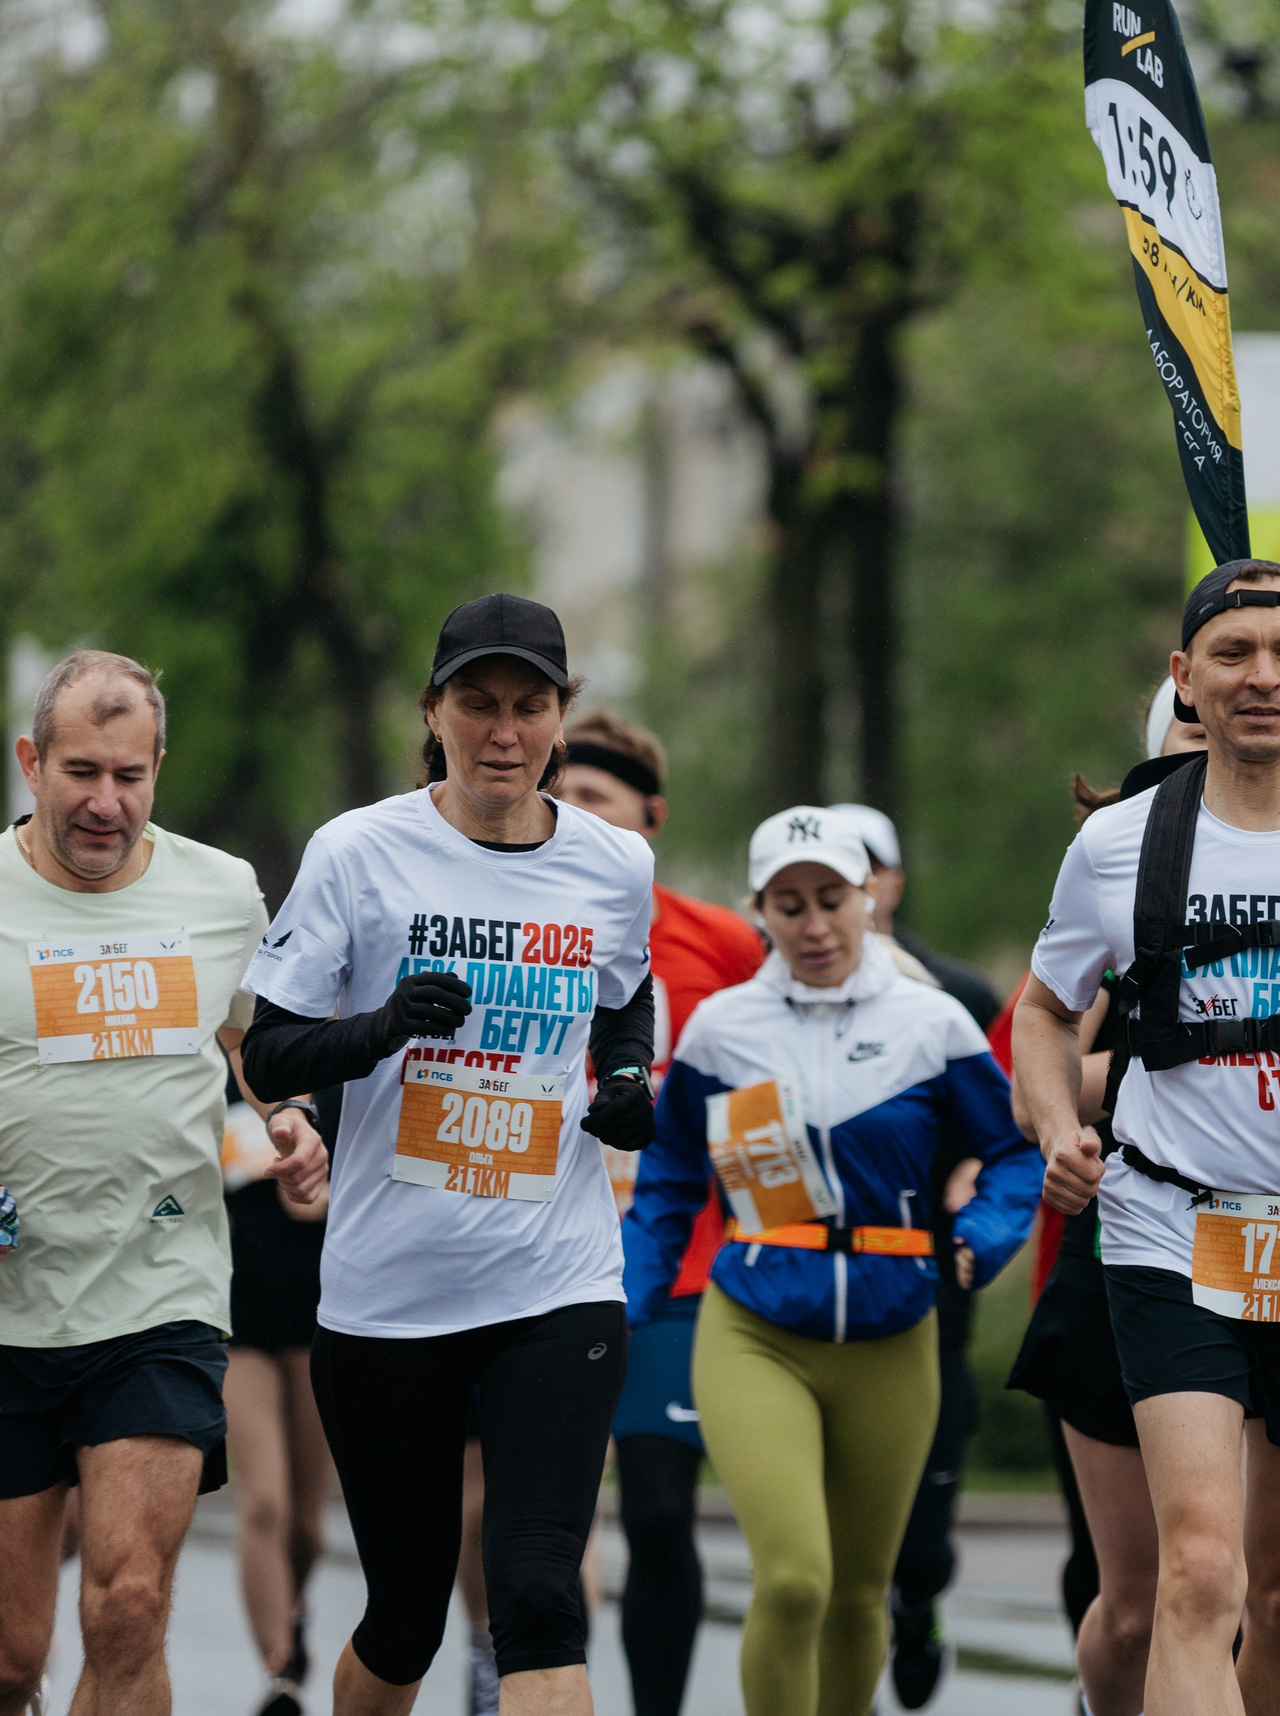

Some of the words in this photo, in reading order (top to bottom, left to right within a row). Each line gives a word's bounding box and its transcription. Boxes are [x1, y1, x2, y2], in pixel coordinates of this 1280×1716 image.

[1113, 2, 1141, 37] RUN
[1137, 48, 1164, 89] LAB
[1108, 102, 1177, 219] 1:59
[408, 913, 594, 969] #ЗАБЕГ2025
[73, 960, 158, 1014] 2150
[466, 962, 594, 1013] ПЛАНЕТЫ
[480, 1008, 575, 1055] БЕГУТ
[431, 1070, 453, 1082] ПСБ
[436, 1092, 533, 1153] 2089
[743, 1118, 800, 1189] 1713
[1222, 1200, 1241, 1211] ПСБ
